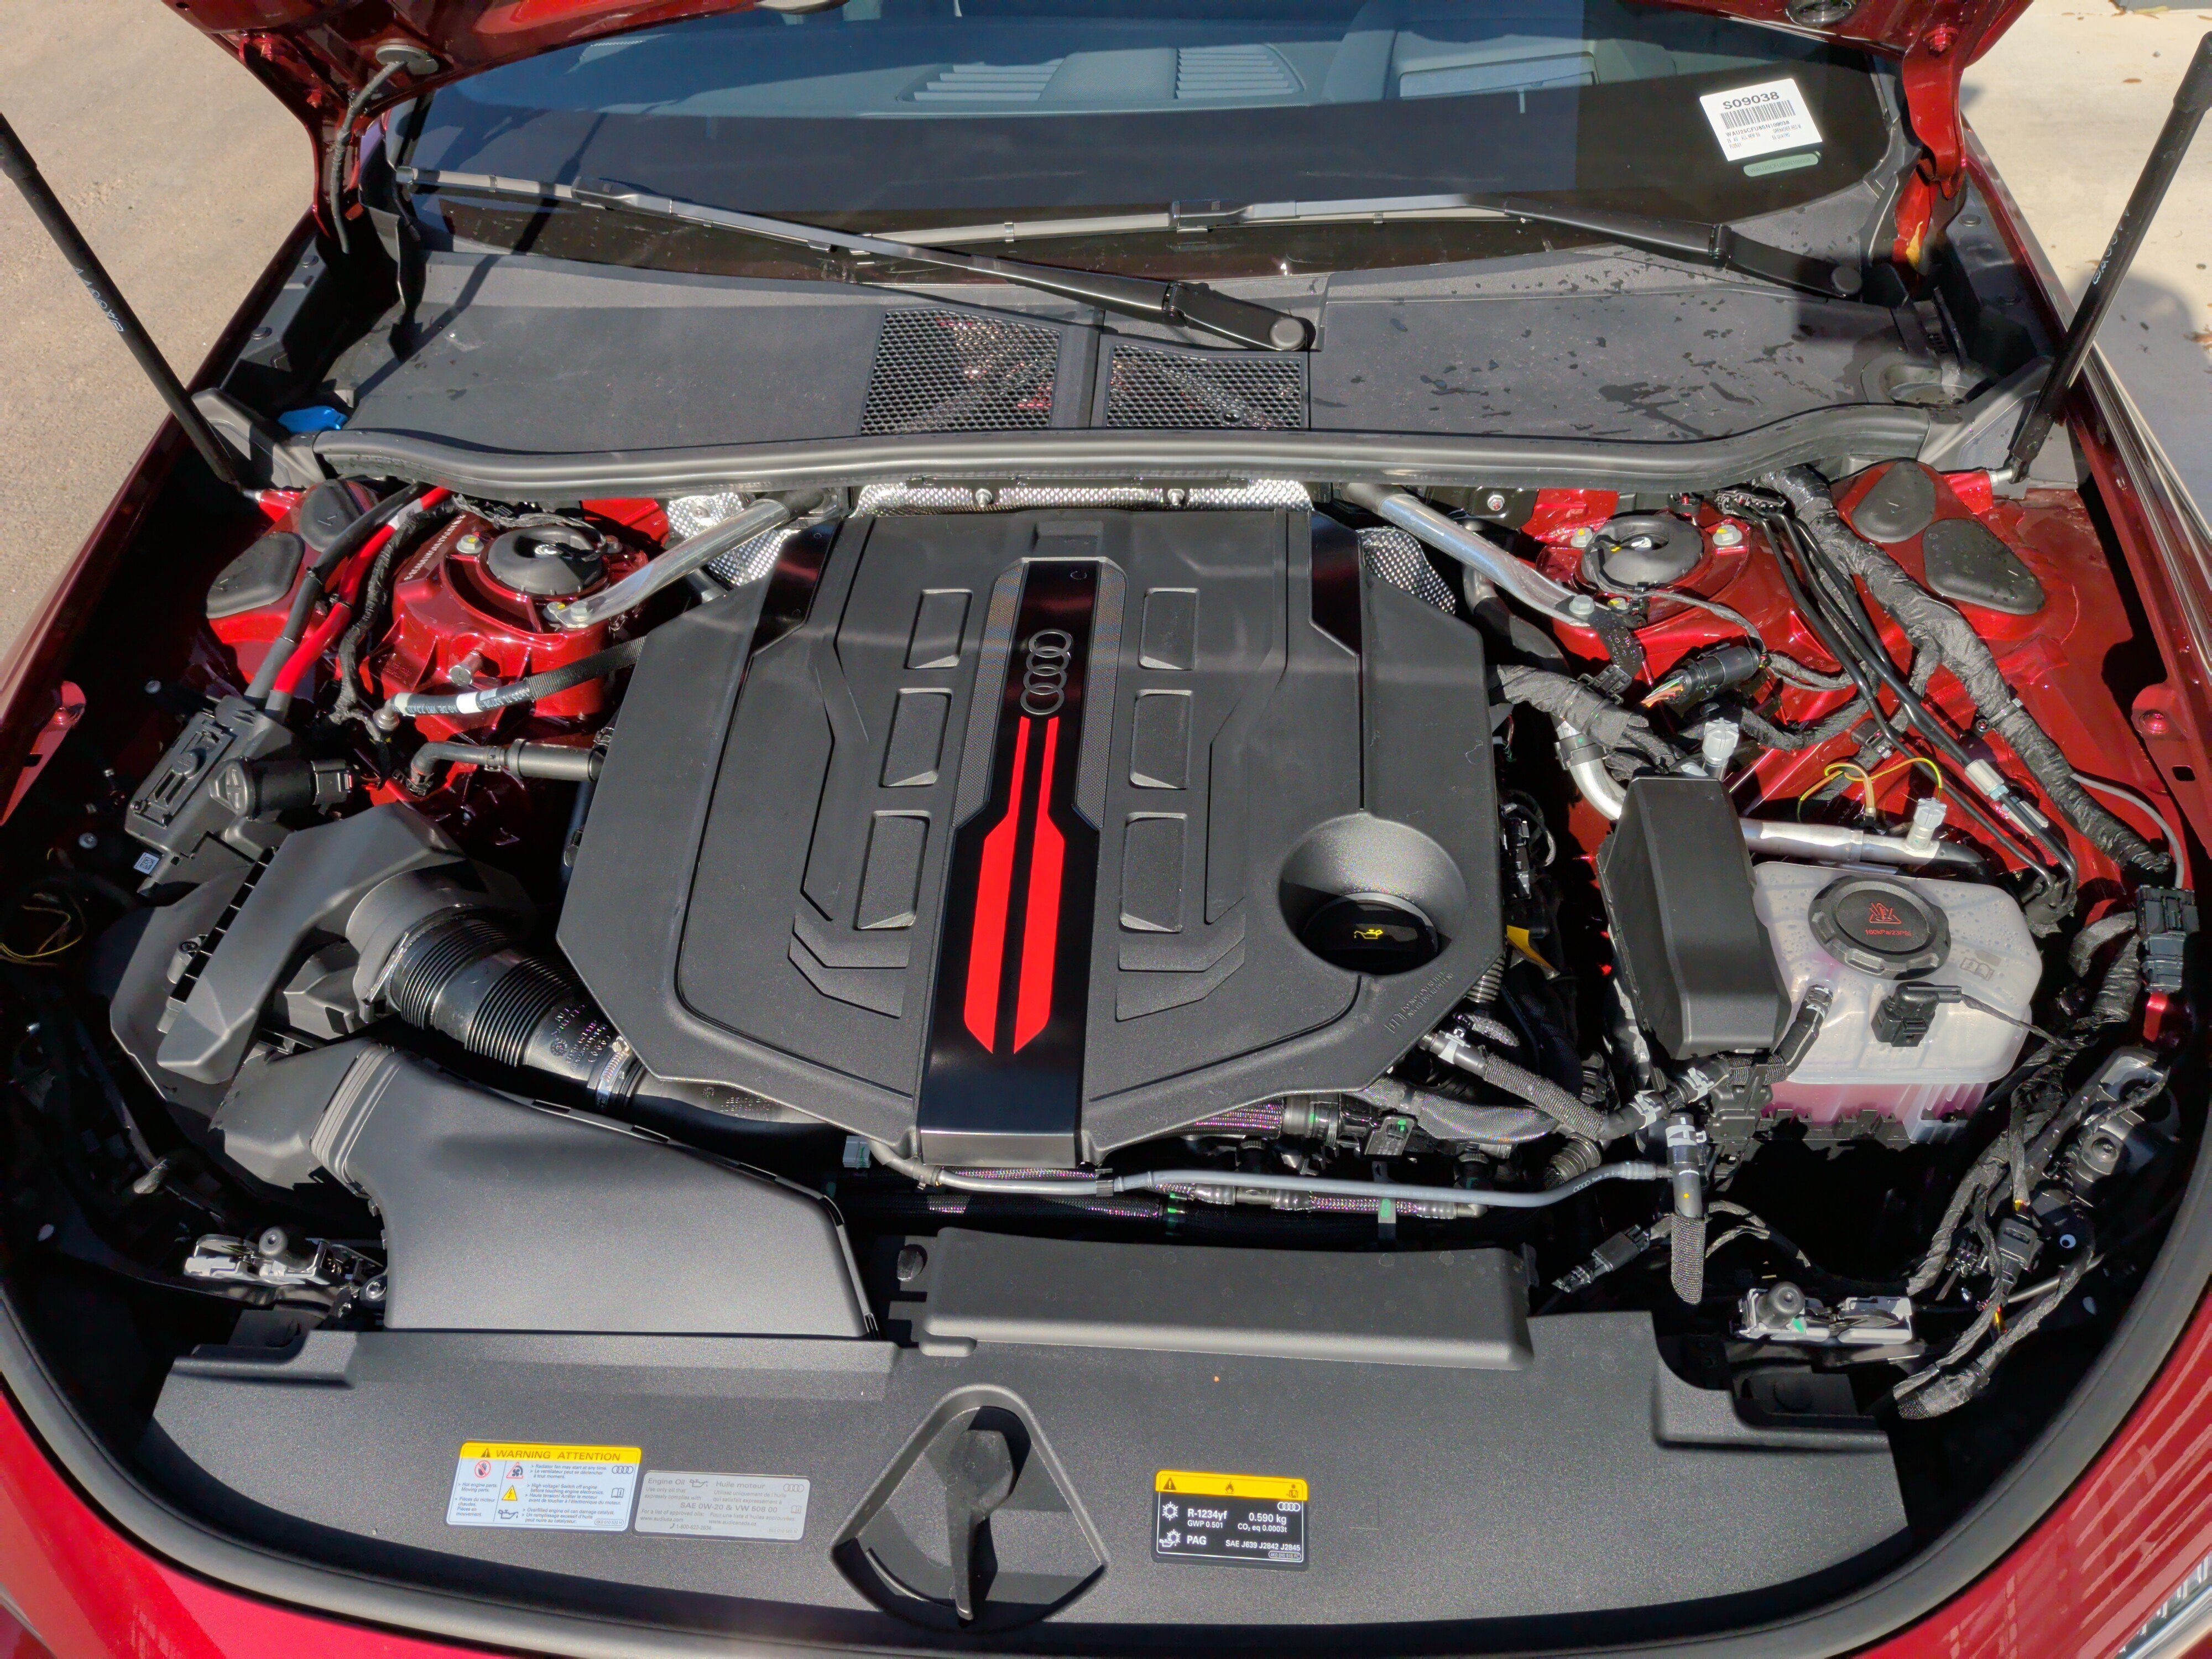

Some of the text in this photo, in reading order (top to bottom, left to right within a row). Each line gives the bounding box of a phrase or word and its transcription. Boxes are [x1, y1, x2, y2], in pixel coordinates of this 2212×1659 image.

[1723, 91, 1780, 109] S09038
[497, 1449, 620, 1461] WARNING ATTENTION
[1188, 1509, 1228, 1521] R-1234yf
[1249, 1513, 1287, 1525] 0.590 kg
[1187, 1535, 1207, 1545] PAG
